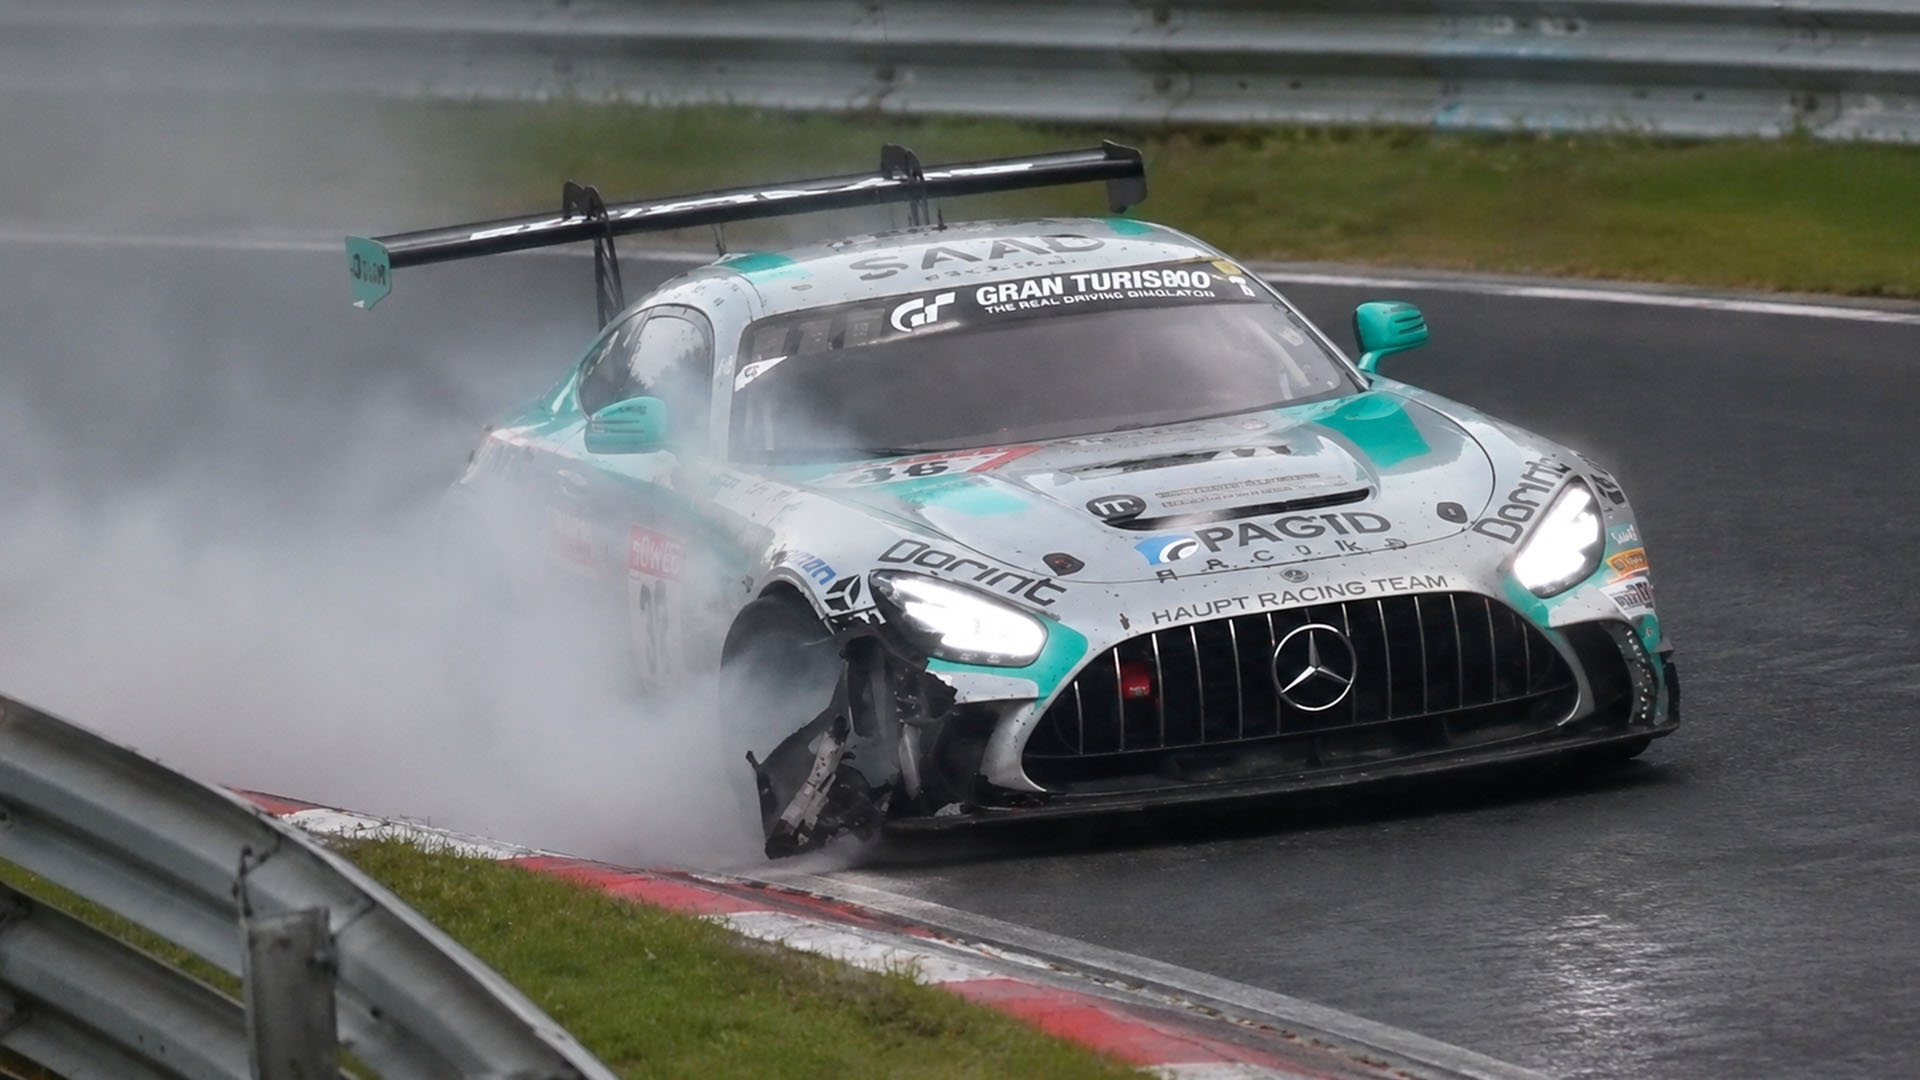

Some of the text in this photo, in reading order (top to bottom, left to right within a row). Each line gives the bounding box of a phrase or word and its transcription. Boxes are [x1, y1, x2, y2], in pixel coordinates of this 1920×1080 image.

[976, 277, 1063, 306] GRAN
[985, 304, 1015, 314] THE
[1019, 298, 1060, 310] REAL
[878, 539, 1067, 606] Dorint
[1152, 575, 1448, 625] HAUPT RACING TEAM
